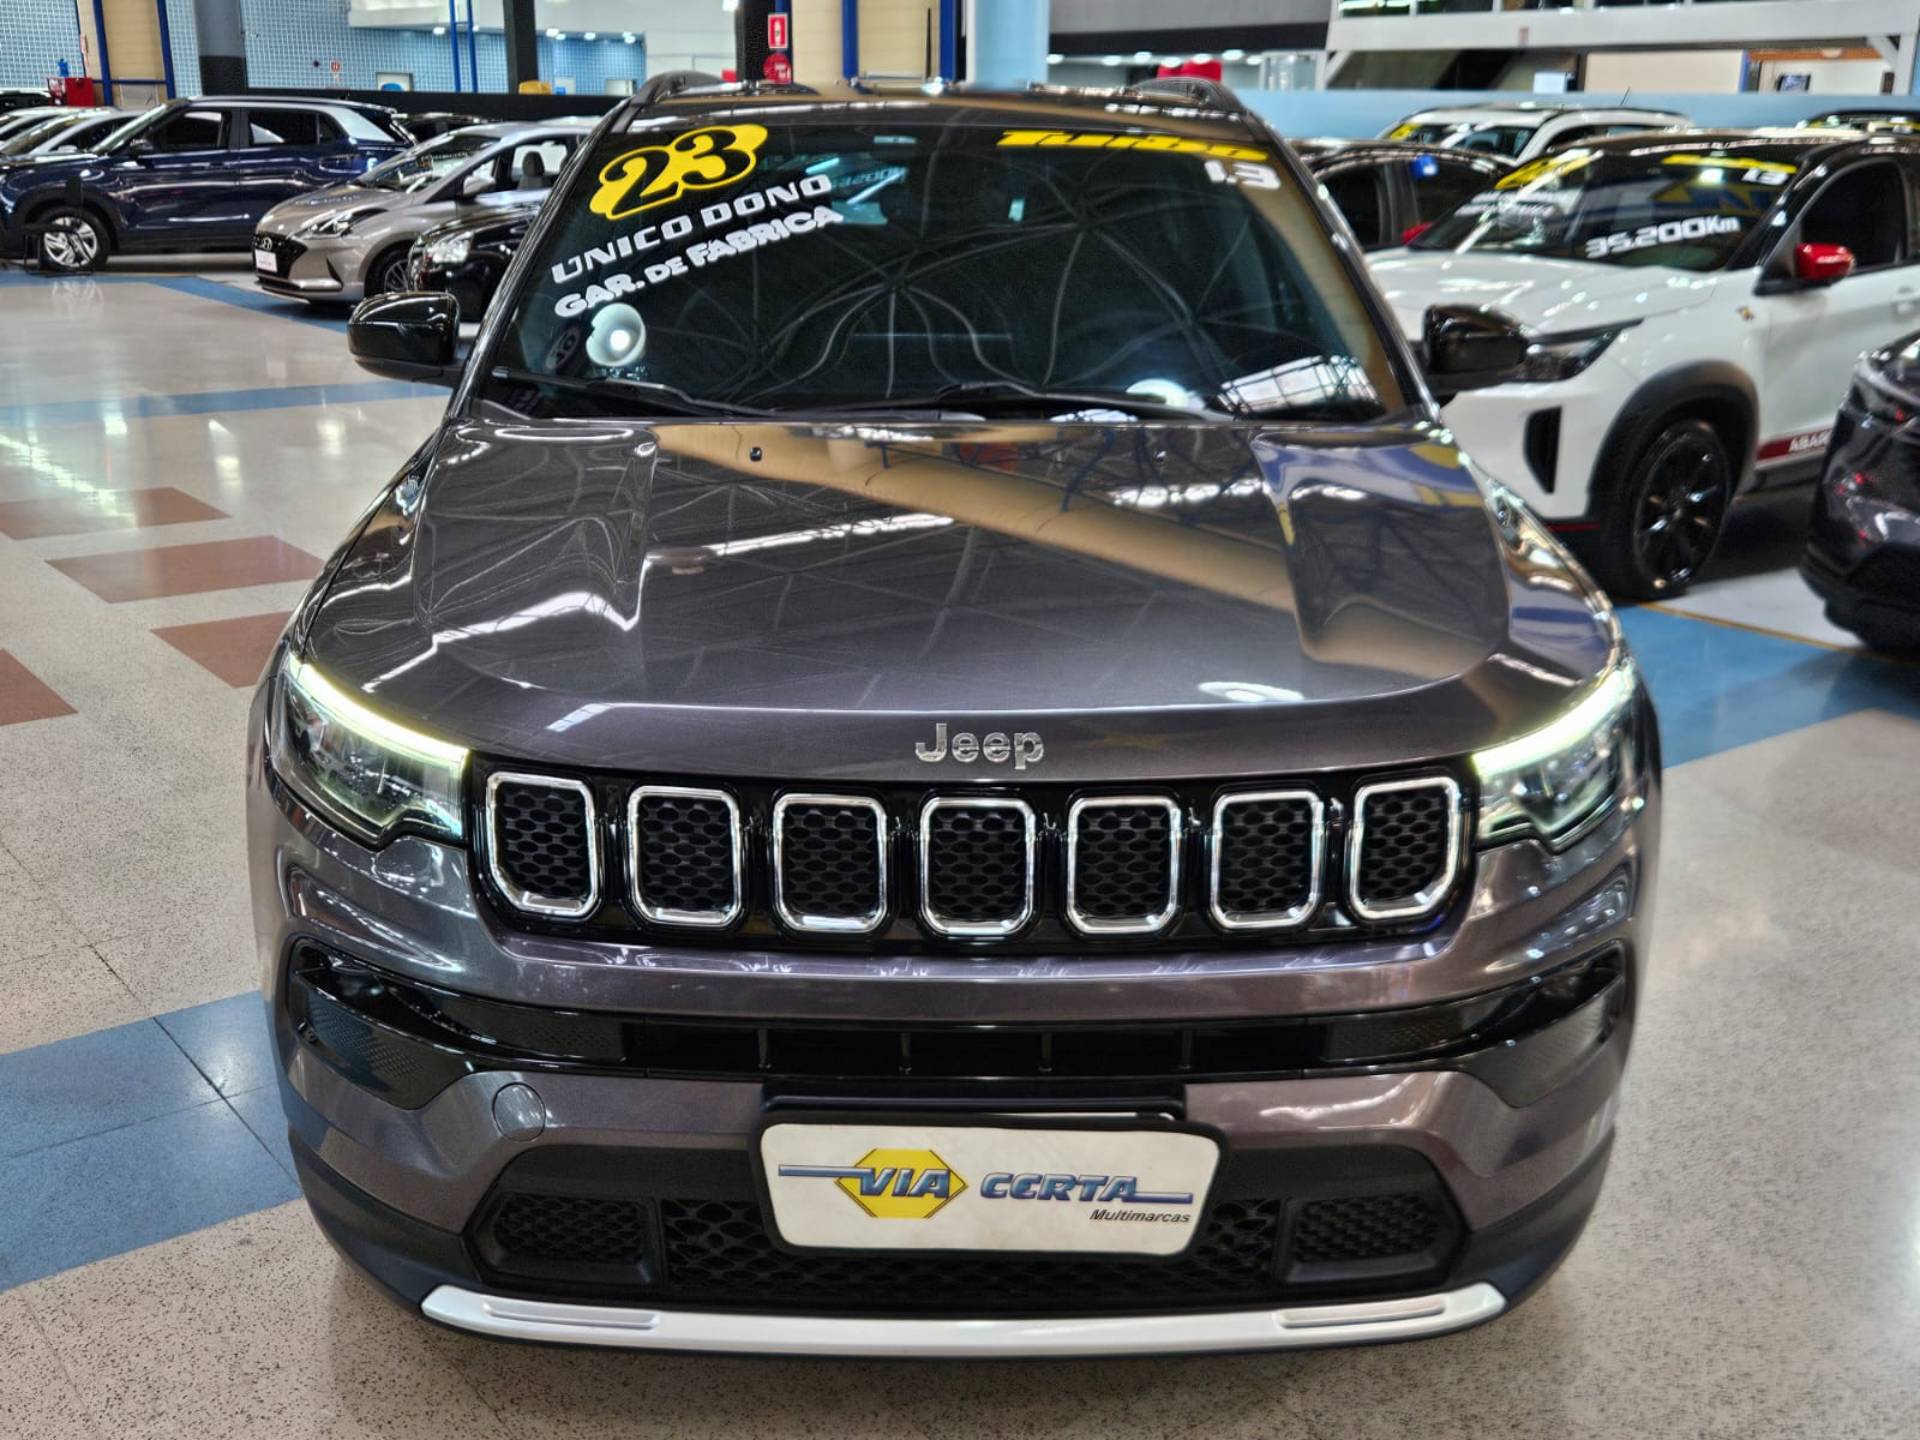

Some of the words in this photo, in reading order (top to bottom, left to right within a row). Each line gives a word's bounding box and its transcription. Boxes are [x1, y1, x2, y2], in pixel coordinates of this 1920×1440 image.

[590, 124, 768, 219] 23
[1204, 160, 1281, 189] 1.3
[701, 174, 832, 227] DONO
[555, 273, 645, 318] GAR.
[645, 255, 688, 283] DE
[915, 722, 1044, 769] Jeep
[858, 1168, 951, 1197] VIA
[1089, 1208, 1191, 1223] Multimarcas
